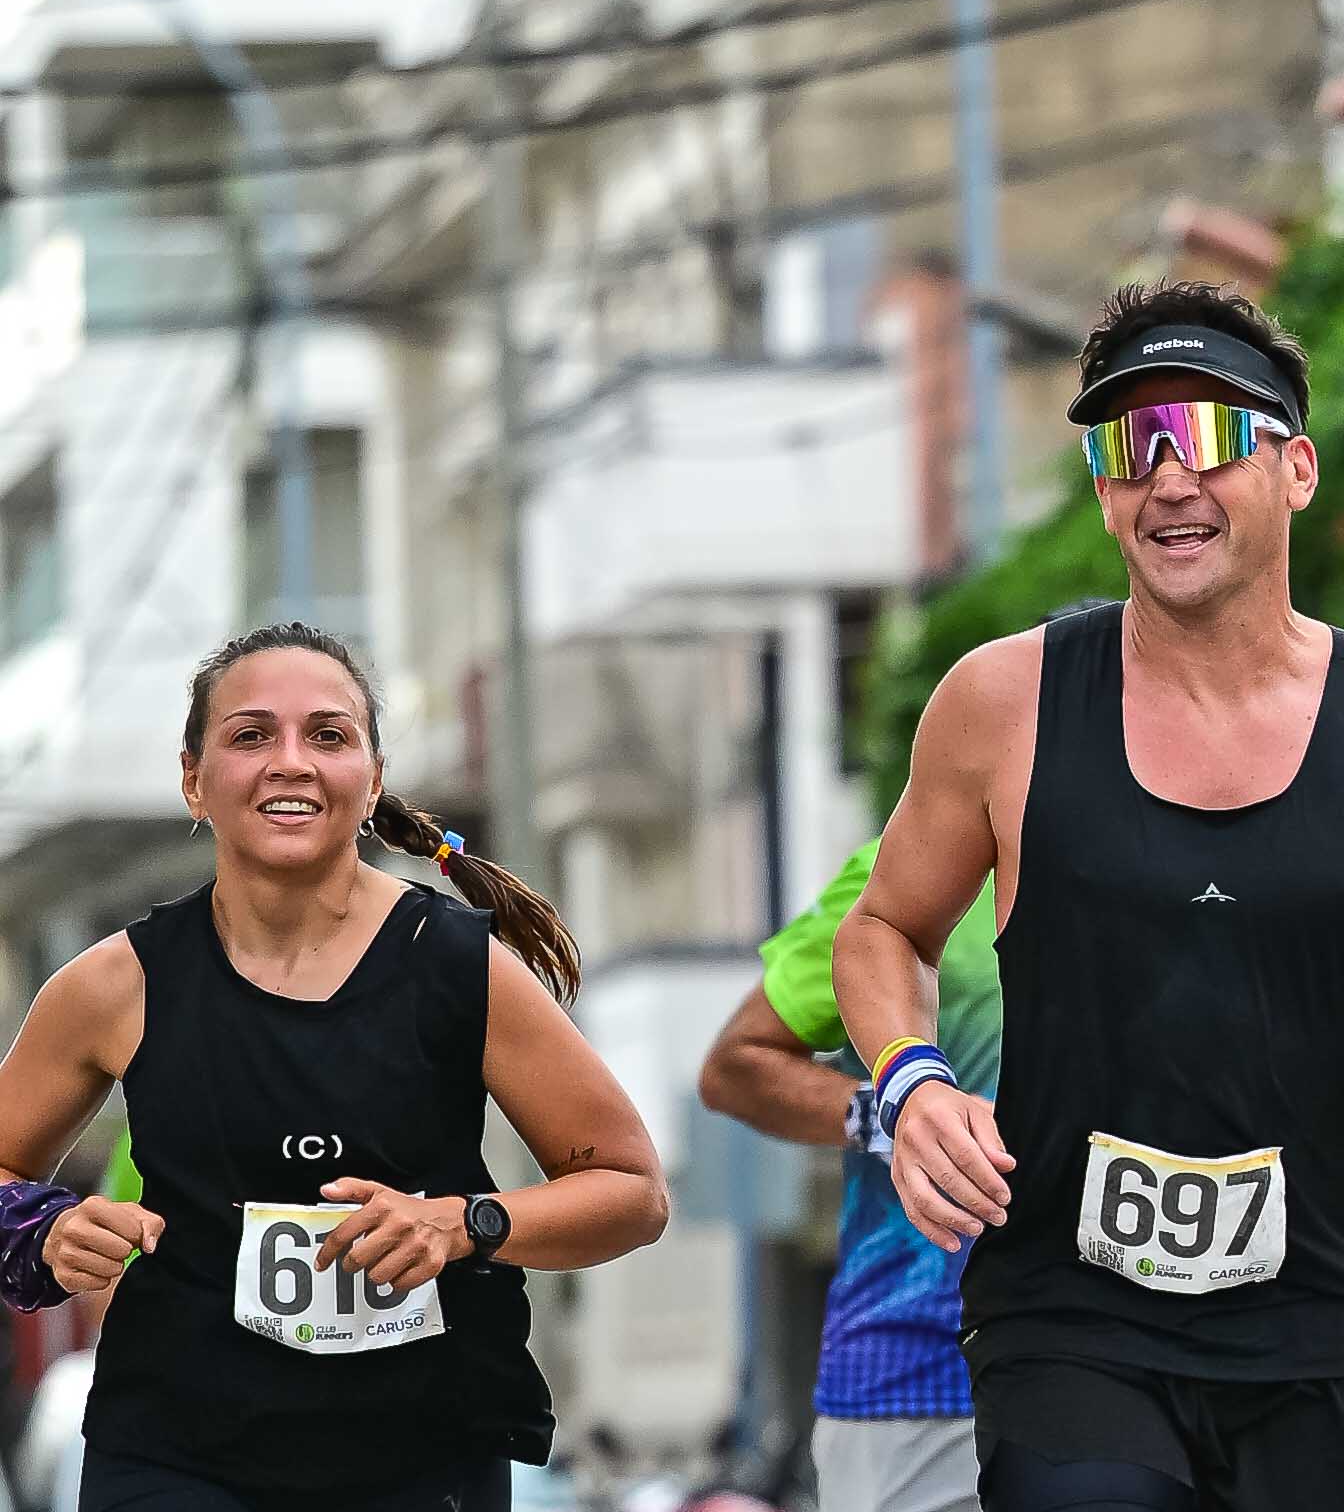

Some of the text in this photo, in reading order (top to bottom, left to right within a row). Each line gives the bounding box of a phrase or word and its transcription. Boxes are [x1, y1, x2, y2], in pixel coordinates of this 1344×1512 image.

[1142, 338, 1205, 355] Reebok
[1100, 1157, 1272, 1259] 697
[1208, 1266, 1267, 1281] CARUSO
[365, 1316, 425, 1336] CARUSO
